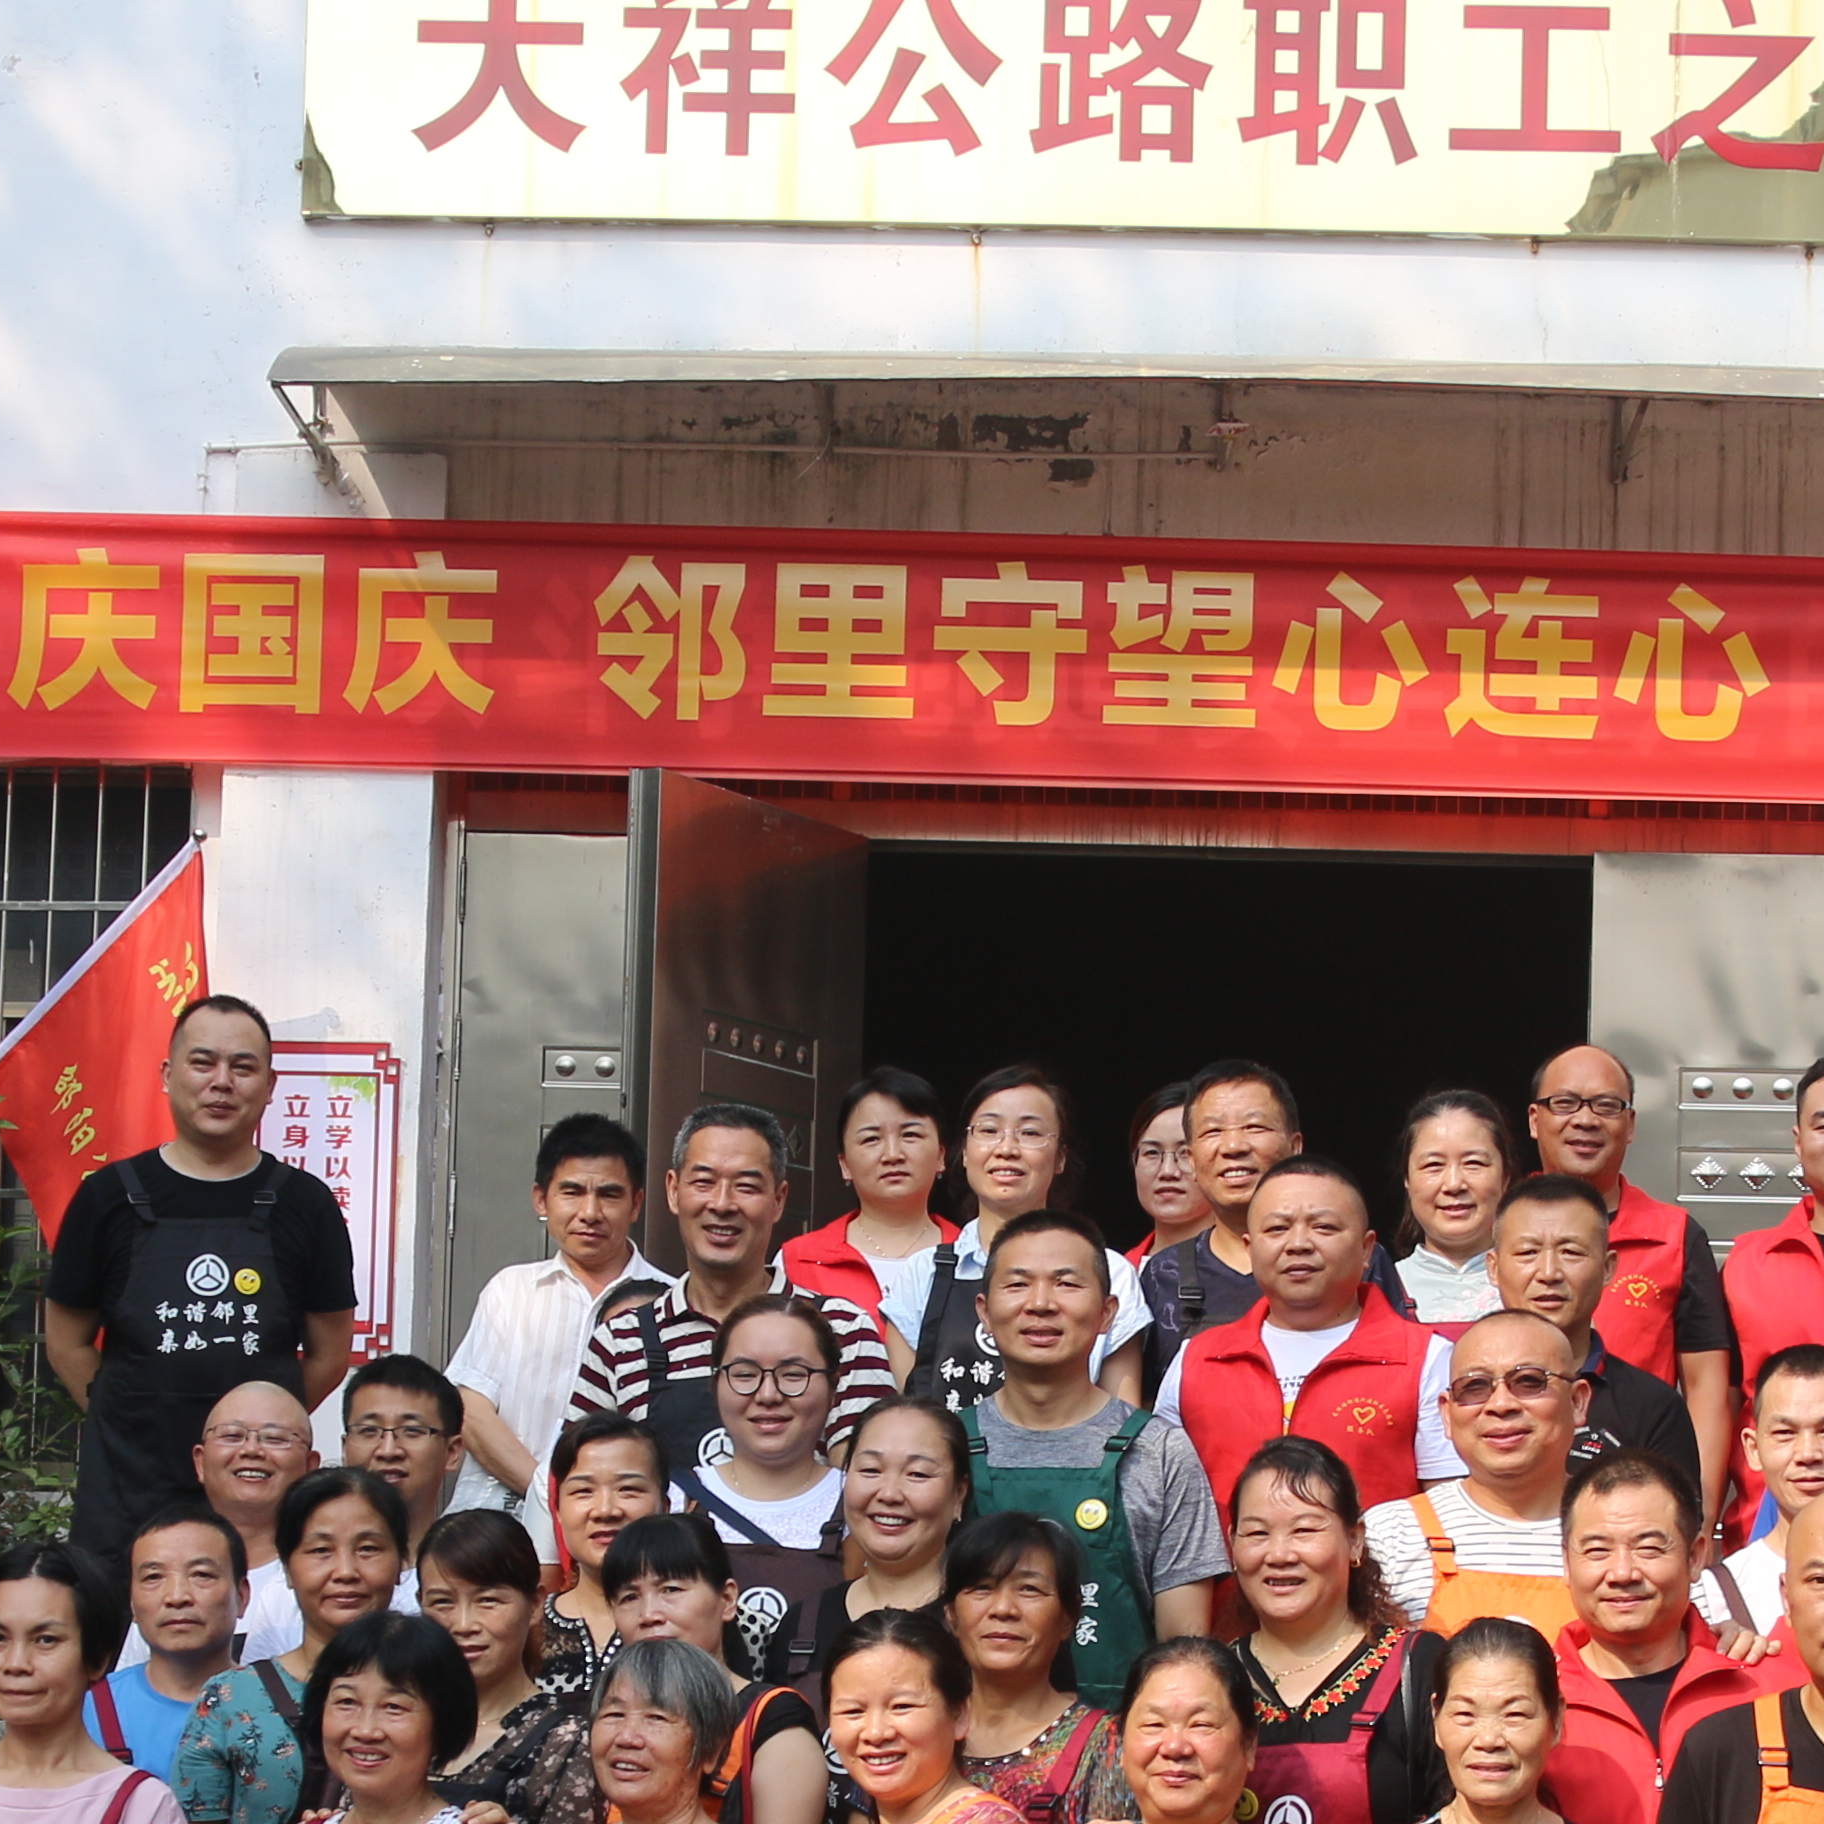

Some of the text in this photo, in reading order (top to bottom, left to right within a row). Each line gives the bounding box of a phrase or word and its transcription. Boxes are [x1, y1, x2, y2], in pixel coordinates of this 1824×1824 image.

[6, 549, 497, 716] 庆国庆
[593, 556, 1771, 744] 邻里守望心连心
[155, 1300, 260, 1325] 和谐邻里
[156, 1328, 260, 1356] 亲如一家
